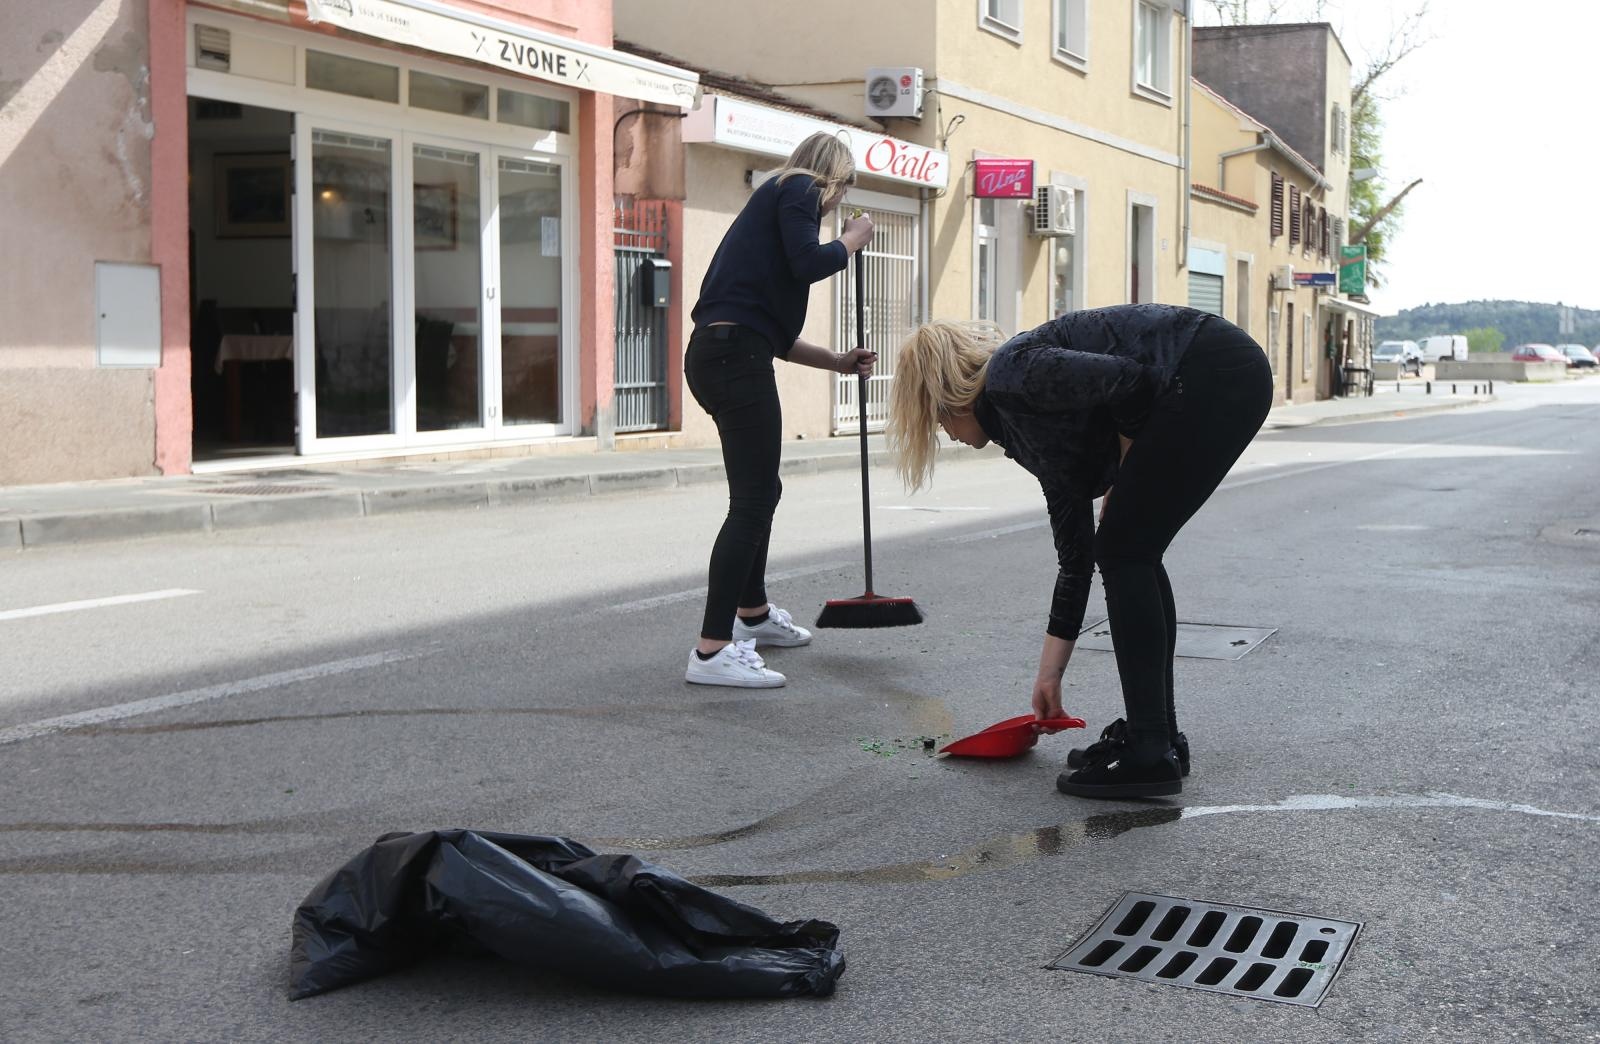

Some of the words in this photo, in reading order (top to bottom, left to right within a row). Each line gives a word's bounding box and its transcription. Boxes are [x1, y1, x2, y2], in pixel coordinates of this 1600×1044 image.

[498, 39, 567, 77] ZVONE
[900, 88, 911, 96] LG
[865, 139, 939, 183] Očale
